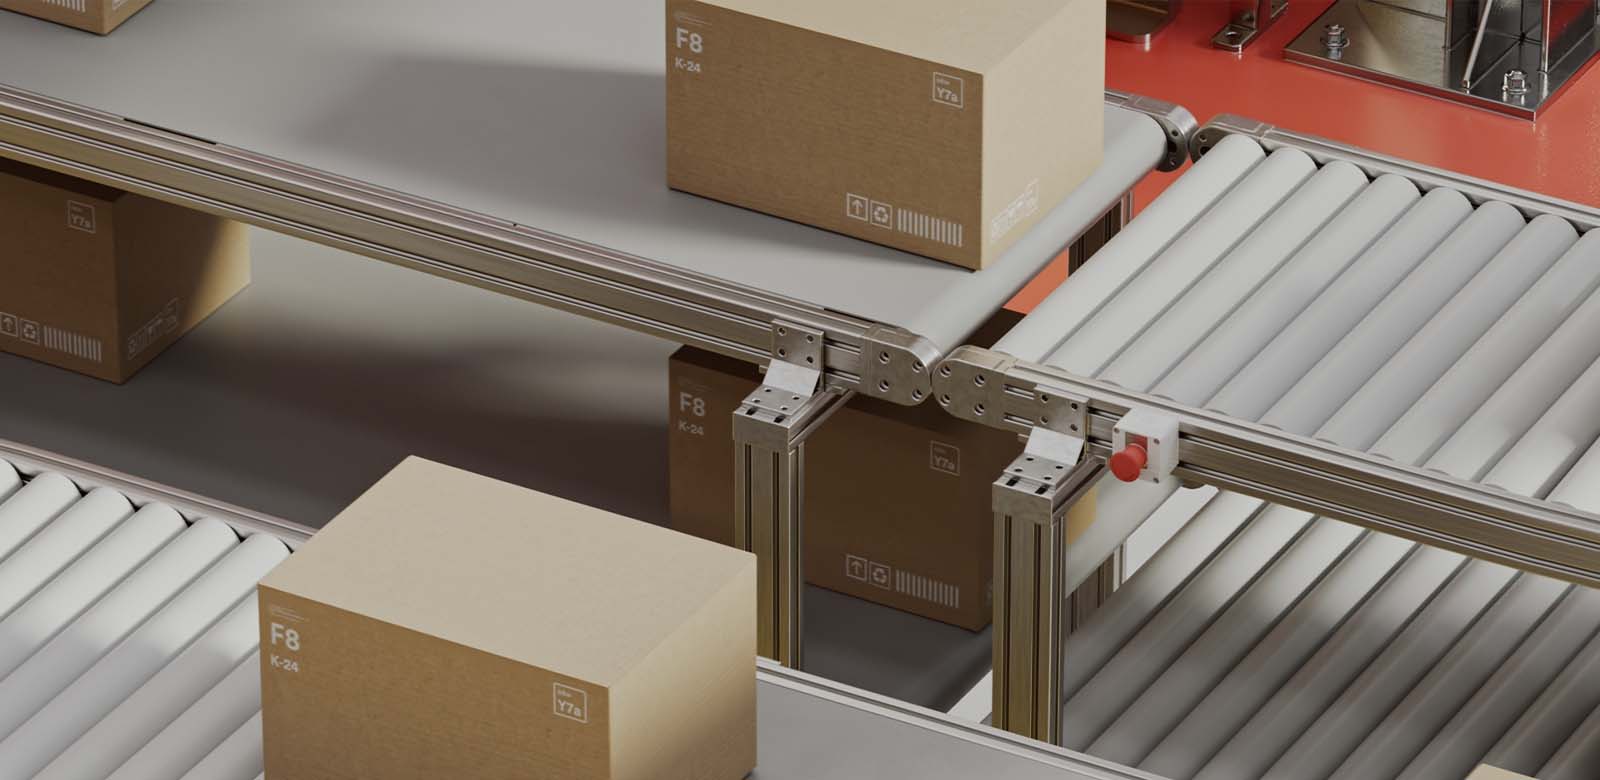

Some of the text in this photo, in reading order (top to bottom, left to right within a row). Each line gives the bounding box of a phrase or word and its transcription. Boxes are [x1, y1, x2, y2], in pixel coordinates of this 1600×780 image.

[676, 27, 704, 54] F8
[675, 56, 702, 73] K-24
[680, 391, 706, 417] F8
[679, 420, 705, 436] K-24
[271, 623, 300, 652] F8
[271, 654, 299, 673] K-24
